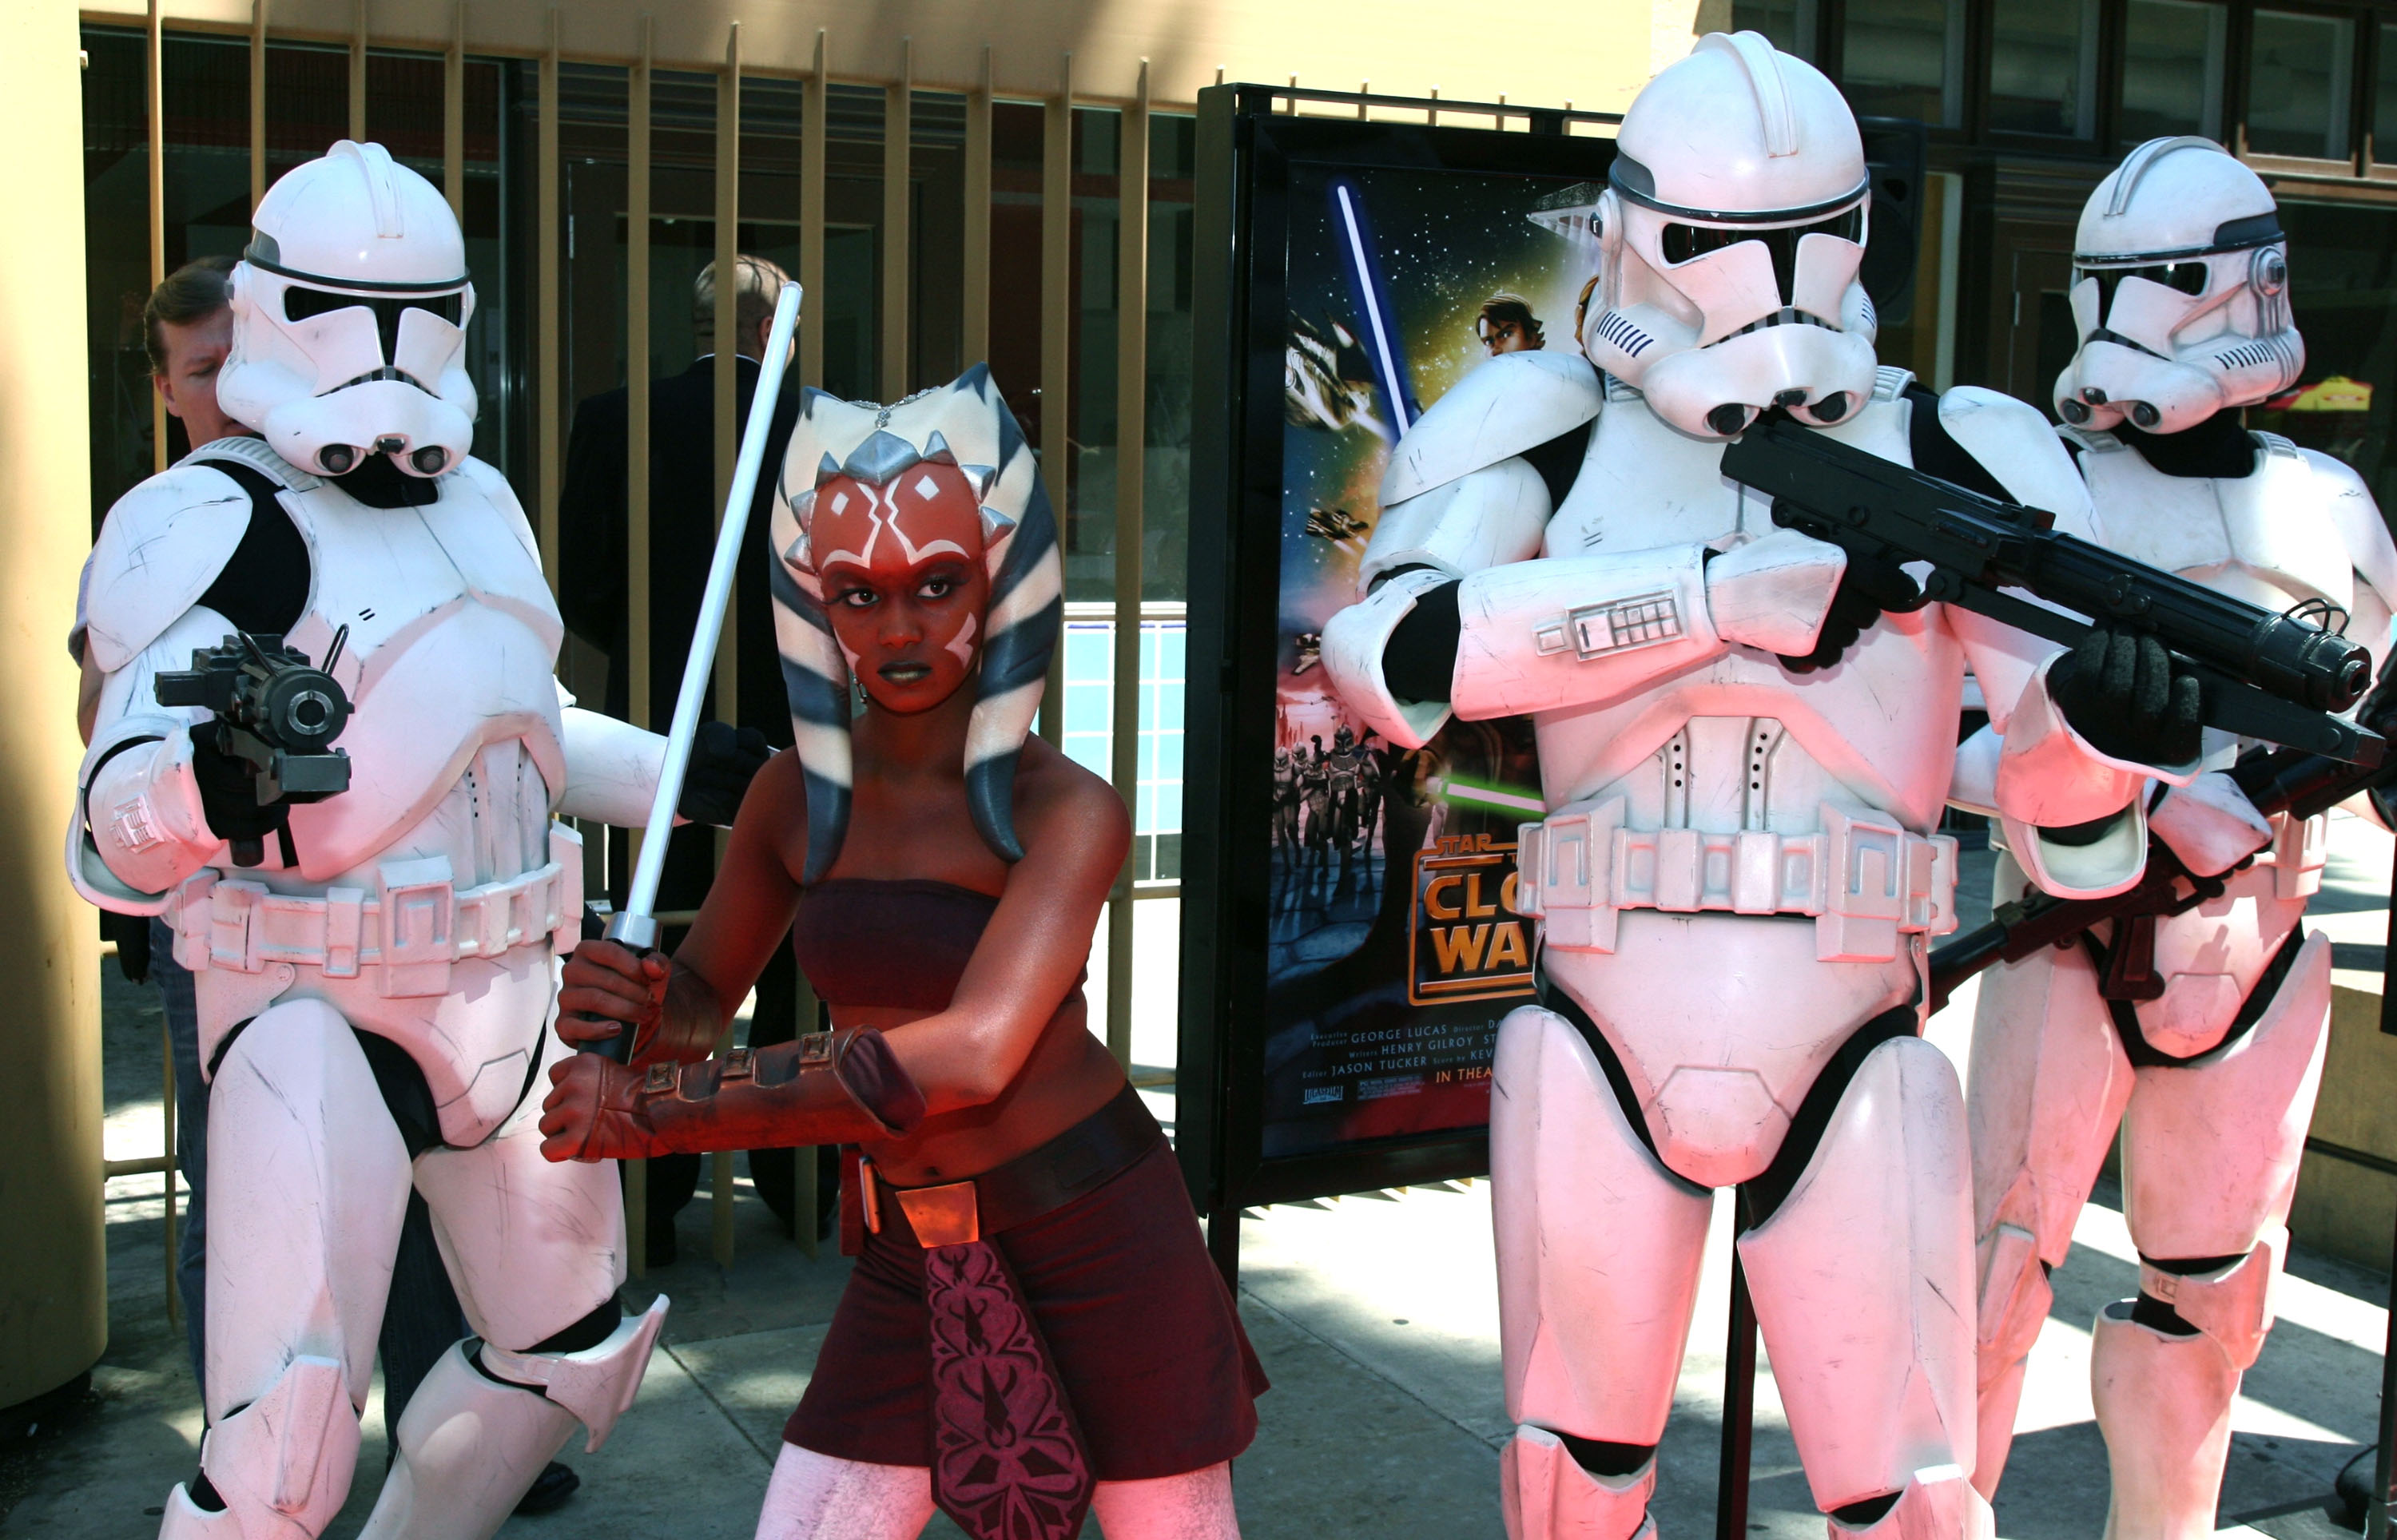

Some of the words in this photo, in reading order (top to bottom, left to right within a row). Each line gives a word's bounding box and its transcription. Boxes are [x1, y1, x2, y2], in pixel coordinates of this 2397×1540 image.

[1435, 832, 1493, 855] STAR
[1429, 921, 1528, 974] WA
[1351, 1029, 1401, 1043] GEORGE
[1408, 1024, 1447, 1038] LUCAS
[1489, 1018, 1502, 1030] DA
[1381, 1041, 1422, 1055] HENRY
[1428, 1035, 1473, 1050] GILROY
[1484, 1034, 1497, 1045] ST
[1332, 1061, 1373, 1078] JASON
[1379, 1056, 1427, 1070] TUCKER
[1470, 1048, 1493, 1060] KEV
[1436, 1070, 1451, 1083] IN
[1457, 1066, 1493, 1081] THEA
